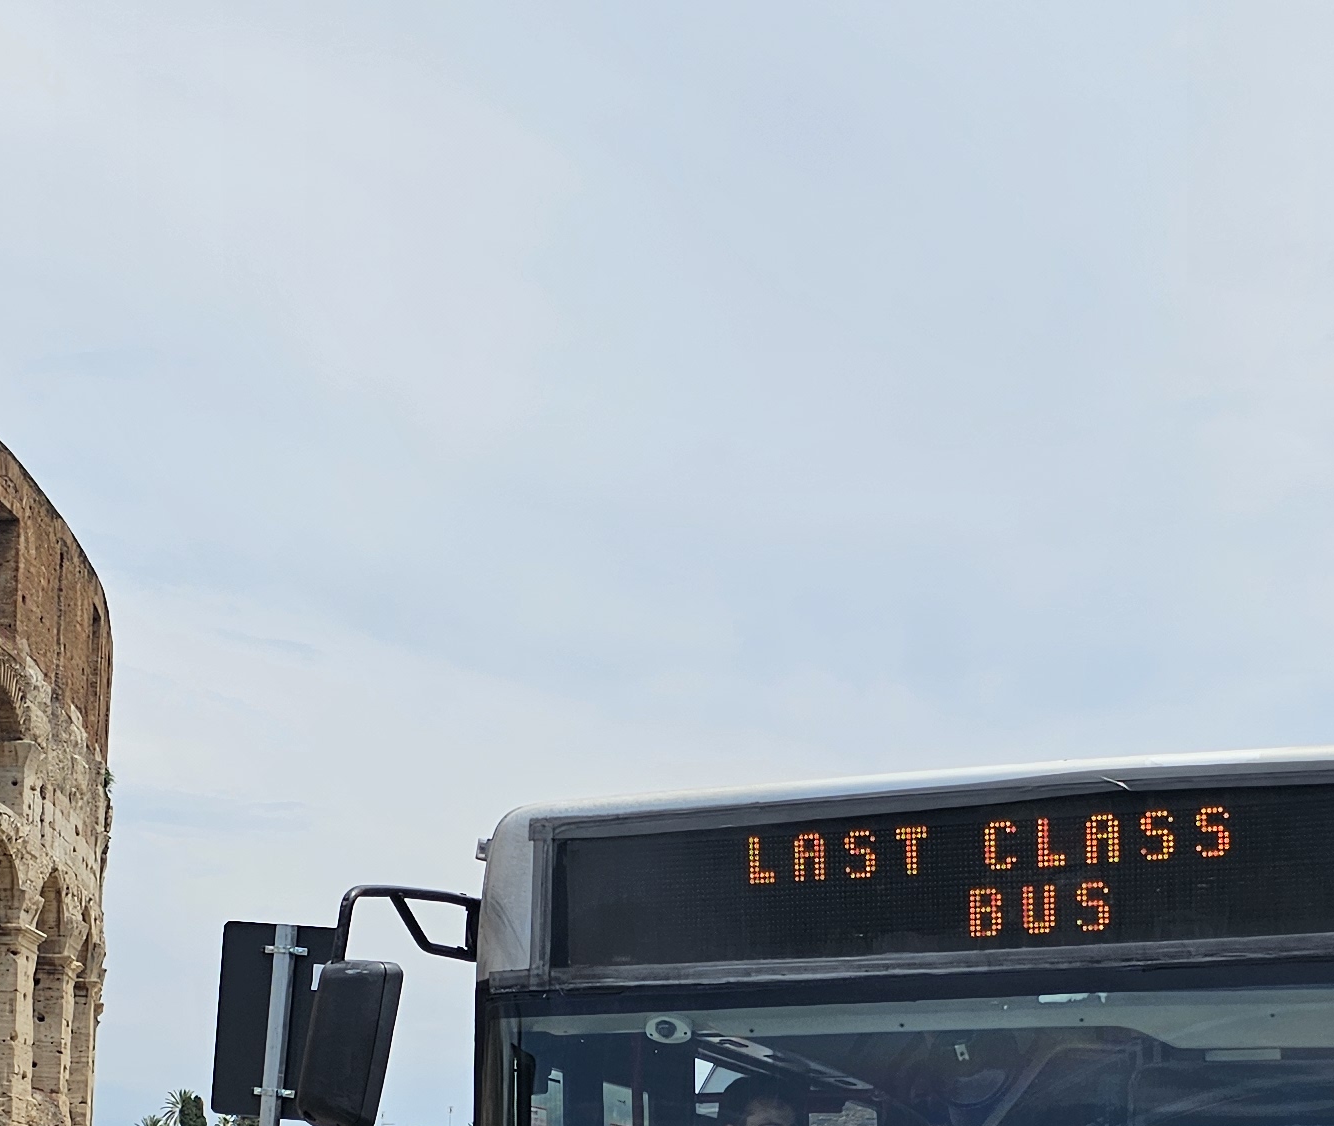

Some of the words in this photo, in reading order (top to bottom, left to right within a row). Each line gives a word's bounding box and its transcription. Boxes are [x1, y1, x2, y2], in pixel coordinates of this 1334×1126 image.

[748, 825, 928, 884] LAST
[983, 806, 1231, 870] CLASS
[969, 880, 1111, 938] BUS
